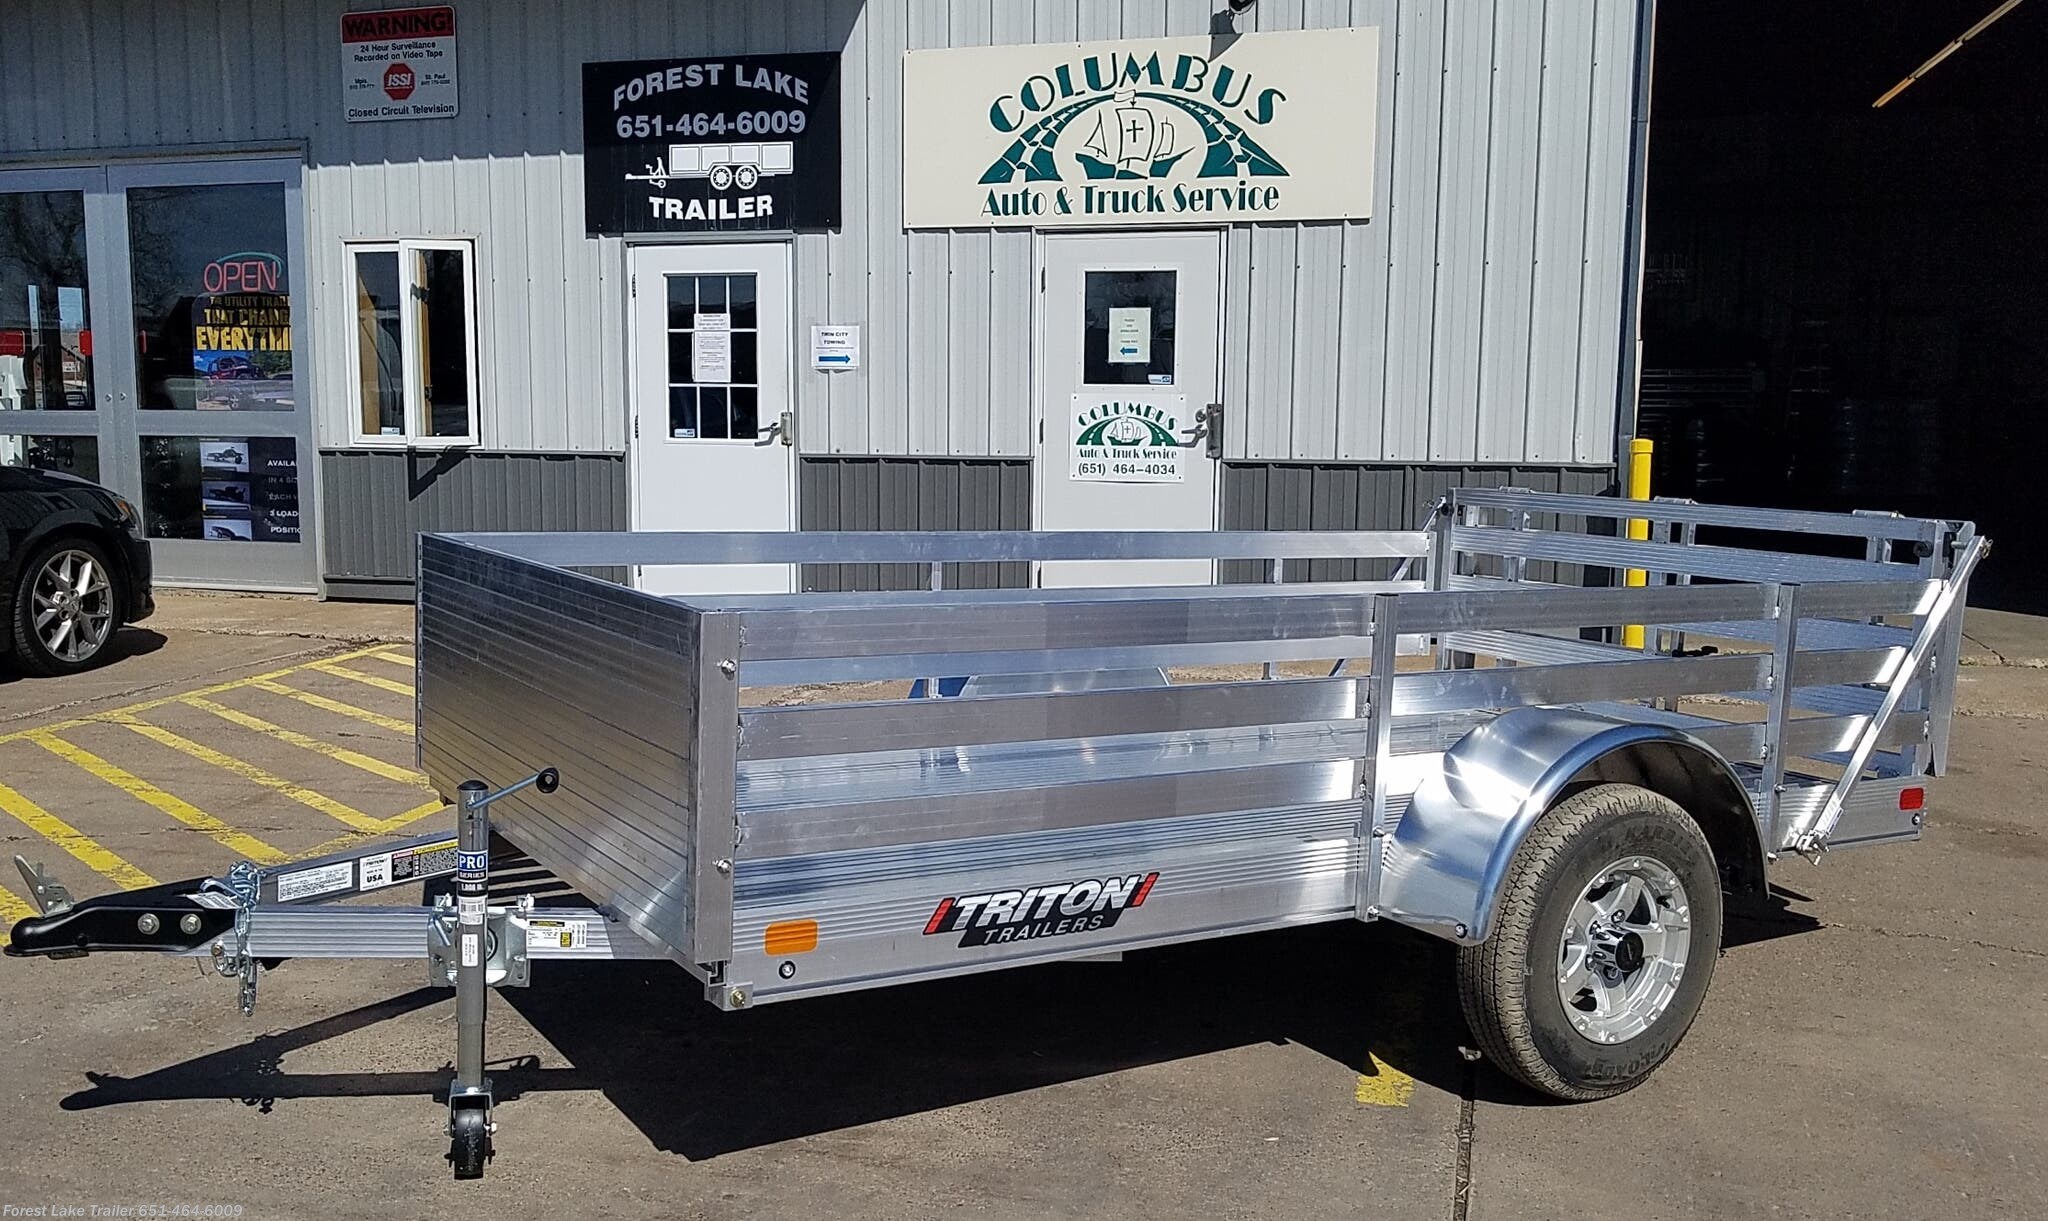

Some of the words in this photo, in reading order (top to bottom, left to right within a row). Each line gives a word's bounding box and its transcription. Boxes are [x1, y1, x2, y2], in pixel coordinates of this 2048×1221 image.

[354, 53, 389, 62] Recorded
[402, 51, 424, 59] Video
[426, 50, 443, 59] Tape
[360, 44, 369, 52] 24
[371, 44, 389, 52] Hour
[391, 41, 436, 51] Surveillance
[613, 63, 724, 111] FOREST
[735, 64, 809, 105] LAKE
[989, 50, 1287, 133] COLUMBUS
[348, 107, 378, 118] Closed
[381, 105, 409, 115] Circuit
[412, 103, 454, 114] Television
[616, 109, 806, 138] 651-464-6009
[648, 195, 773, 220] TRAILER
[981, 187, 1048, 217] Auto
[1053, 186, 1073, 216] &
[1080, 184, 1165, 214] Truck
[1171, 180, 1280, 213] Service
[203, 261, 278, 292] OPEN
[204, 308, 234, 325] THAT
[195, 326, 293, 351] EVERYTHI
[1078, 401, 1178, 430] COLUMBUS
[1112, 448, 1140, 459] Truck
[1142, 448, 1177, 459] Service
[1078, 462, 1106, 476] (651)
[1112, 464, 1175, 475] 464-4034
[459, 854, 485, 869] PRO
[366, 874, 383, 883] USA
[951, 874, 1141, 931] TRITON
[983, 914, 1105, 945] TRAILERS
